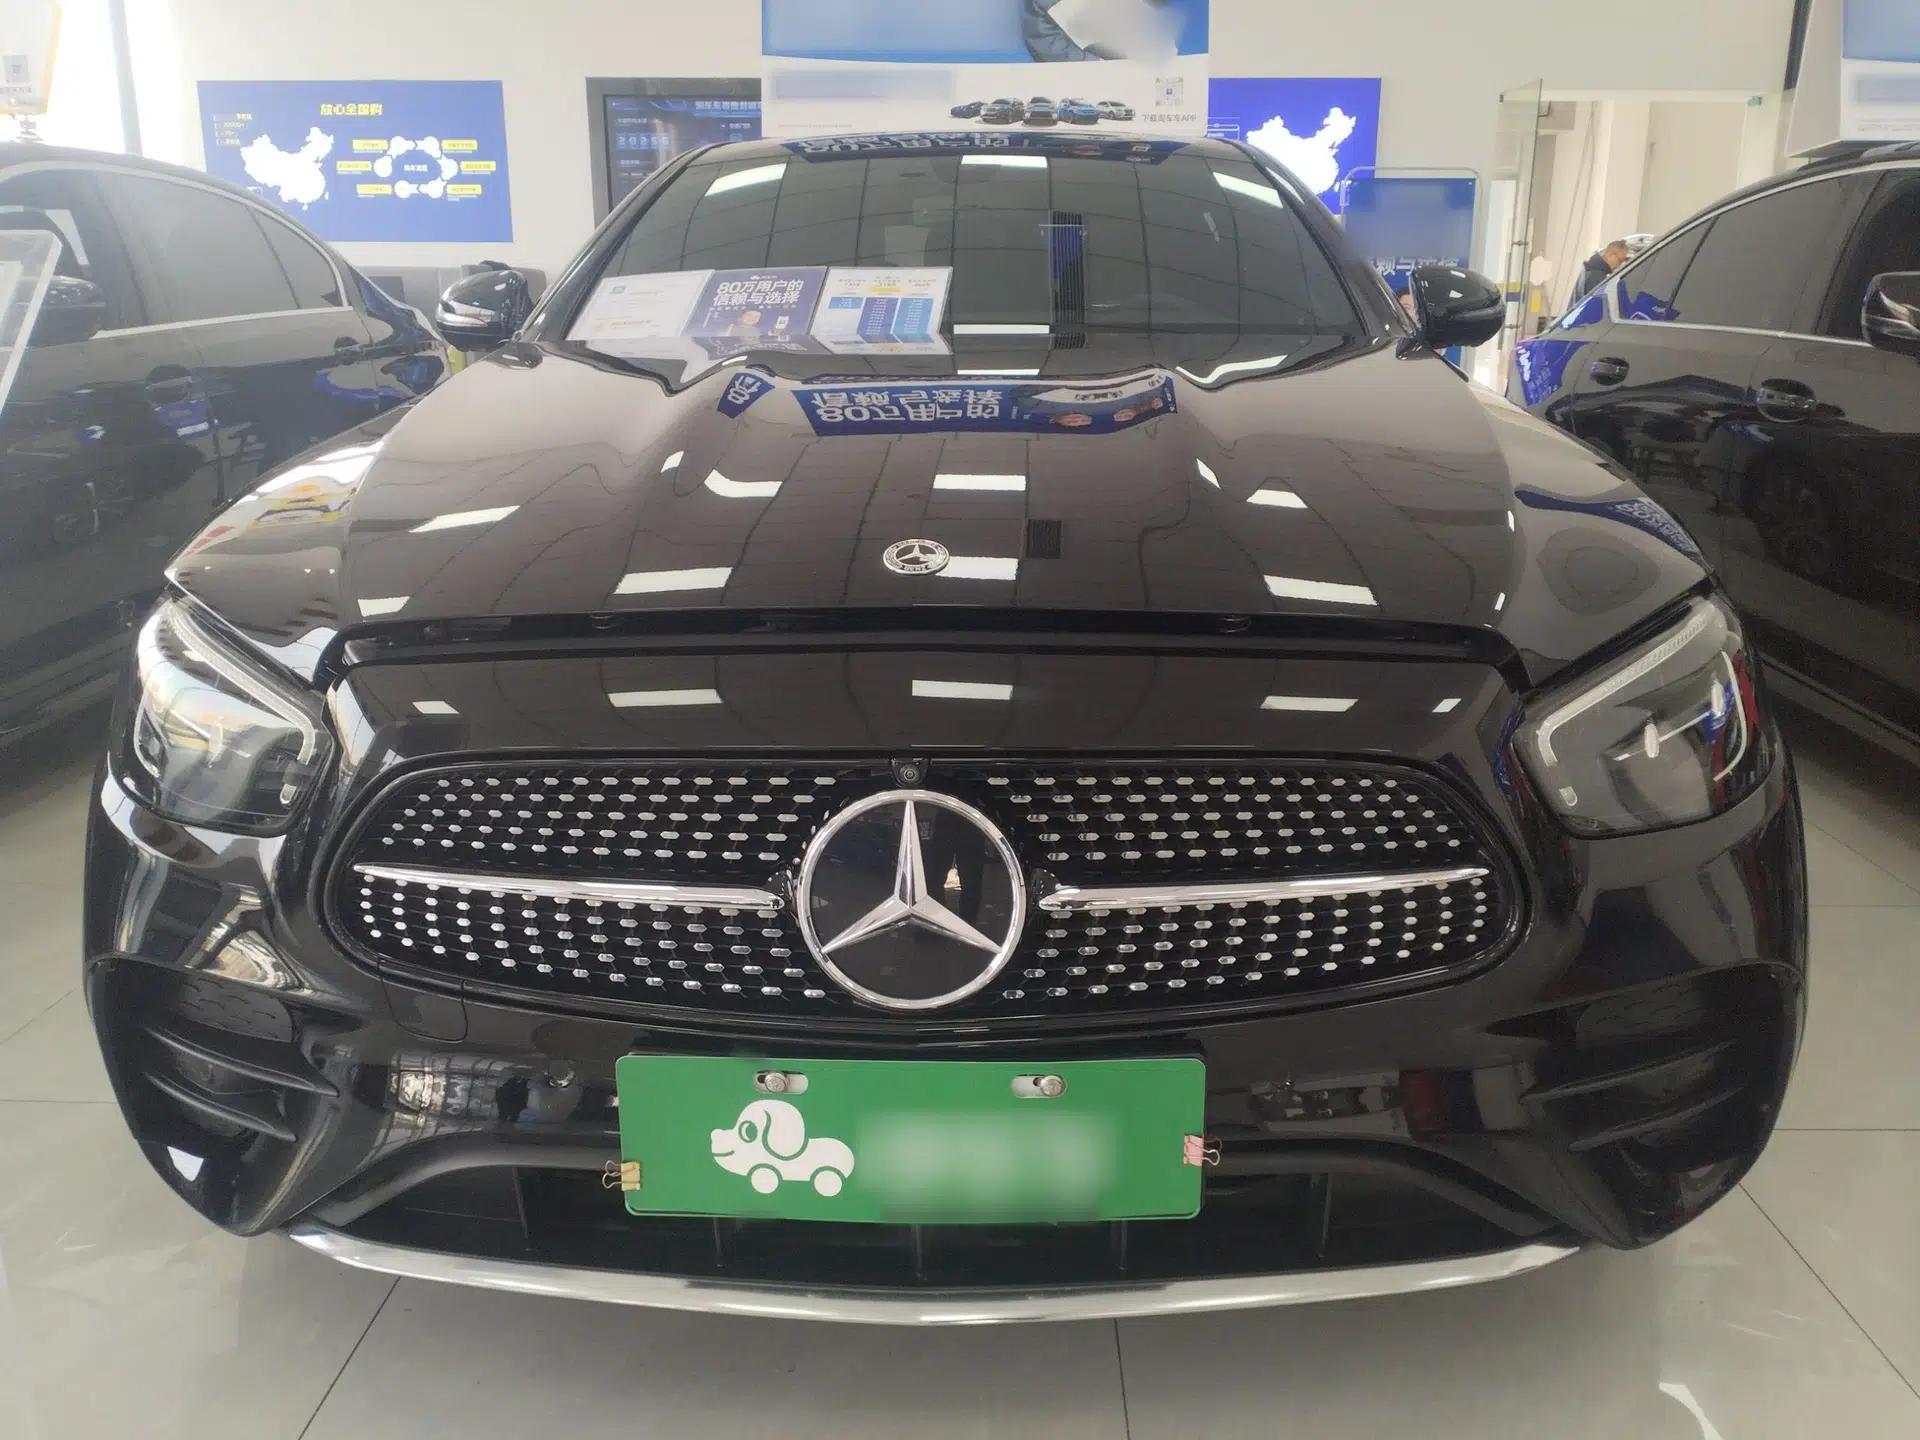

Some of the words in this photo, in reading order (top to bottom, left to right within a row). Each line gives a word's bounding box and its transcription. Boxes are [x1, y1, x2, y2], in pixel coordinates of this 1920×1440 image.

[320, 103, 383, 116] 放心全国购
[716, 279, 805, 294] 80万用户的
[713, 291, 801, 306] 信赖与选择
